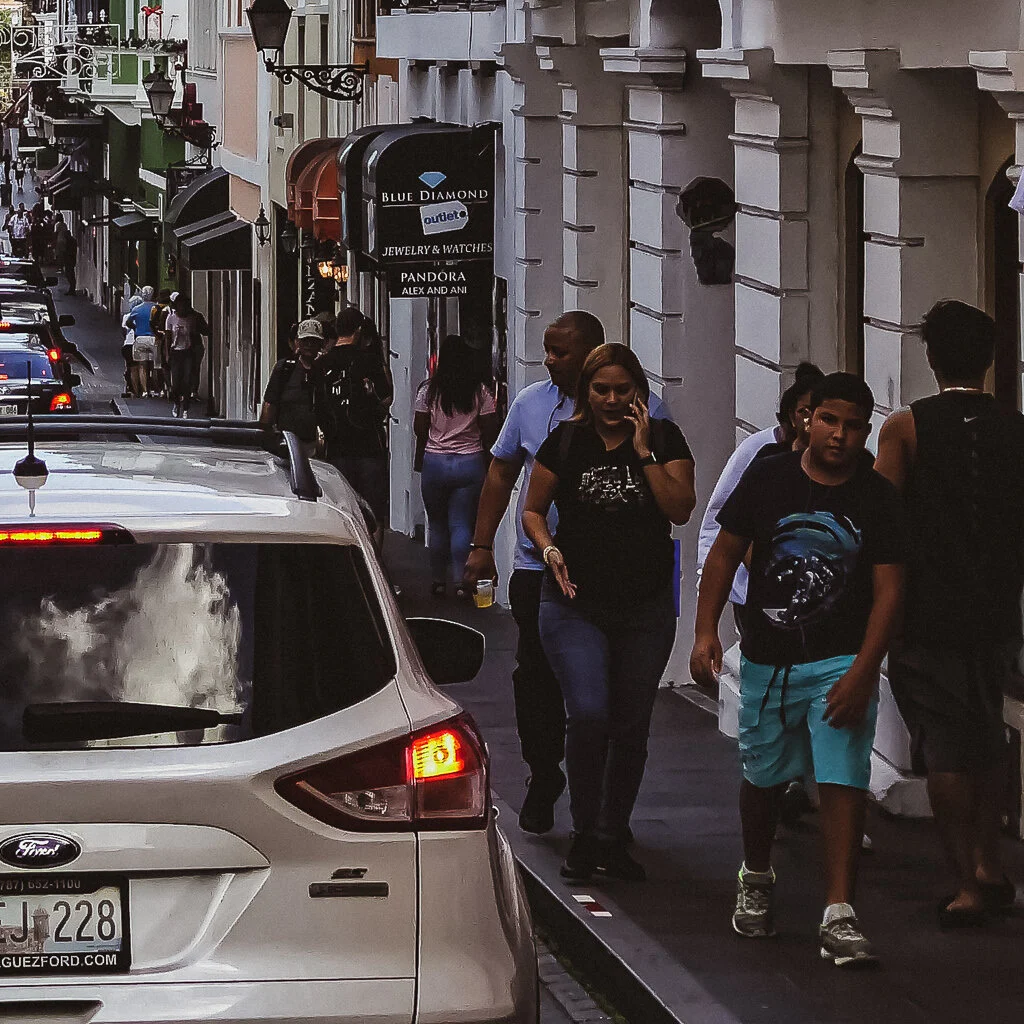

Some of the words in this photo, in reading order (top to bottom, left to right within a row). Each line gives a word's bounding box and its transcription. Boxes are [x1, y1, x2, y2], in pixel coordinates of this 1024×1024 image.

[382, 192, 413, 202] BLUE
[420, 189, 488, 201] DIAMOND
[423, 210, 460, 225] outlet
[382, 245, 431, 257] JEWELRY
[432, 244, 441, 254] &
[442, 242, 494, 254] WATCHES
[401, 271, 467, 283] PANDORA
[402, 286, 425, 295] ALEX
[427, 286, 448, 295] AND
[450, 286, 467, 294] ANI
[53, 899, 116, 943] 228
